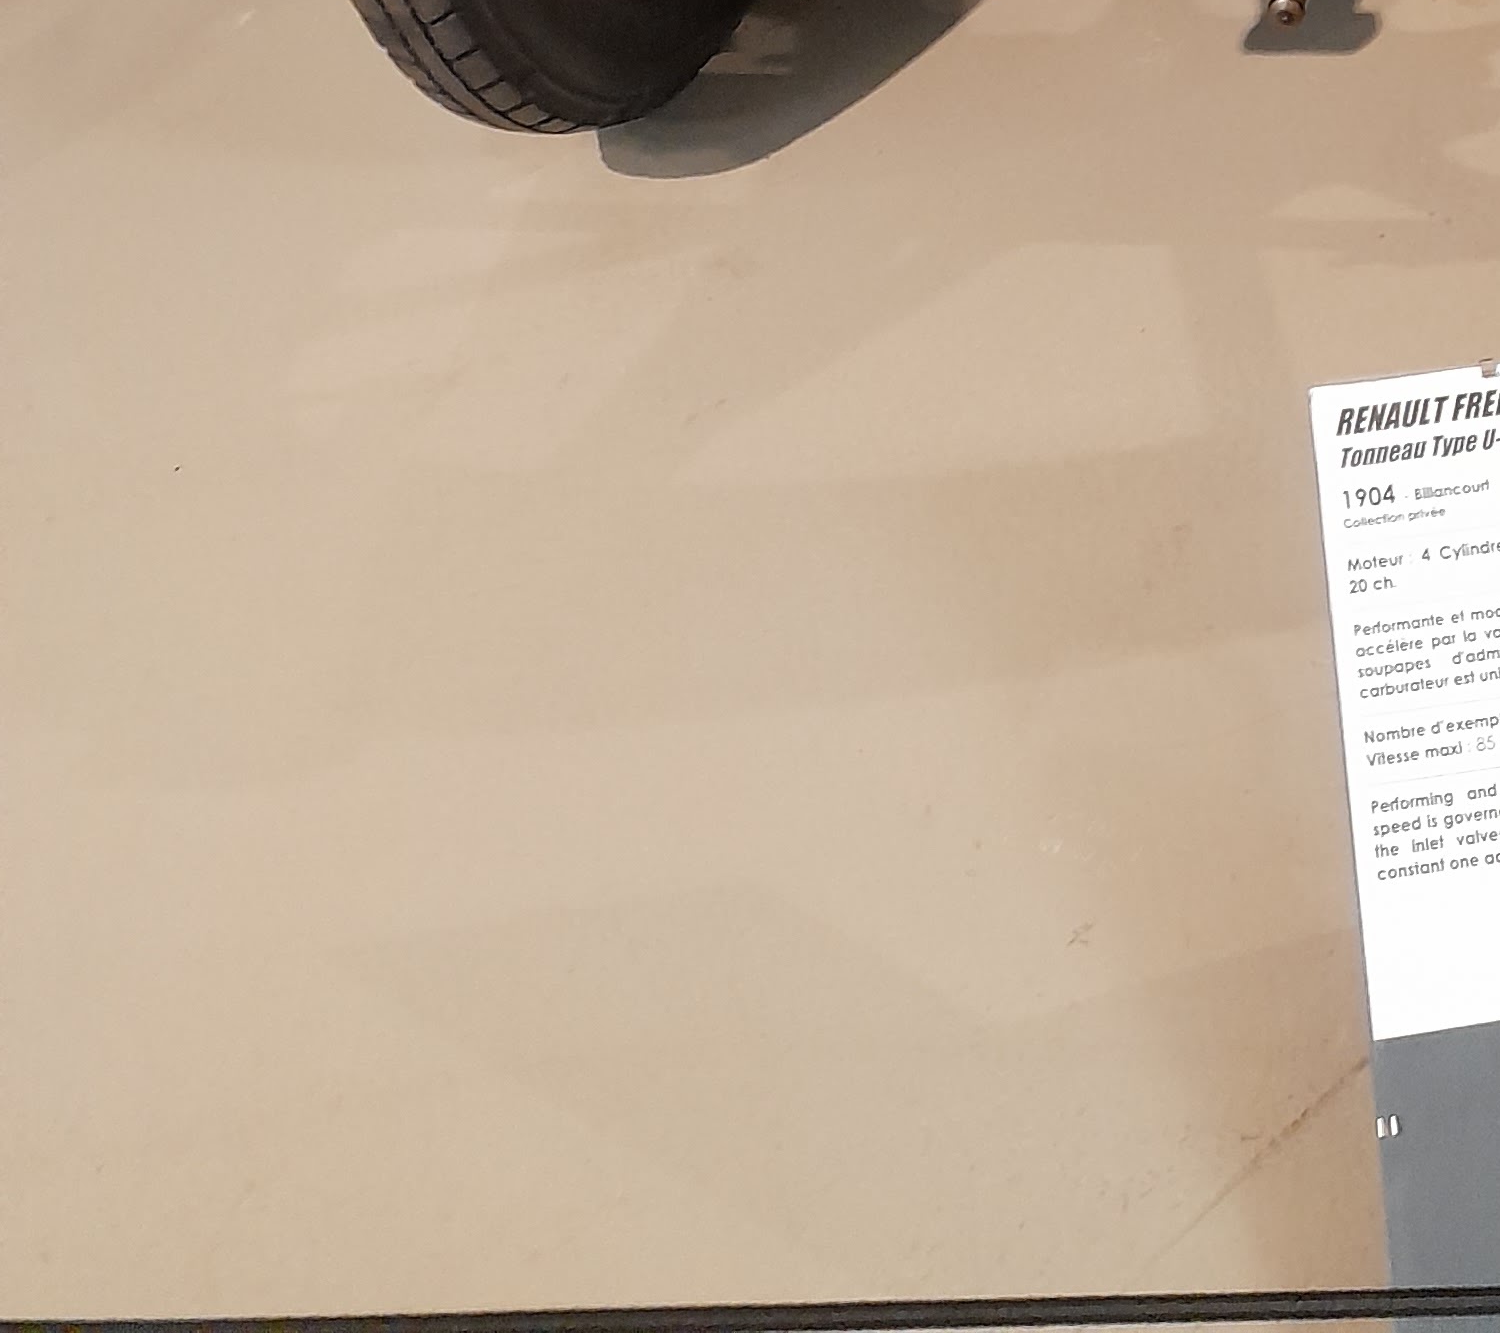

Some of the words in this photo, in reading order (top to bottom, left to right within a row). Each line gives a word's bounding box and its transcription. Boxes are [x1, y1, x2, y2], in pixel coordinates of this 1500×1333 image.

[1335, 395, 1449, 437] RENAULT
[1340, 440, 1428, 469] Tonneau
[1431, 433, 1479, 458] Type
[1342, 483, 1396, 510] 1904
[1343, 513, 1405, 529] Collection
[1347, 554, 1404, 572] Moteur
[1421, 547, 1431, 562] 4
[1348, 578, 1368, 595] 20
[1353, 613, 1445, 637] Performante
[1450, 609, 1465, 624] et
[1355, 637, 1424, 658] accélère
[1431, 634, 1456, 651] par
[1462, 629, 1478, 643] la
[1356, 658, 1432, 679] soupapes
[1359, 676, 1450, 700] carburateur
[1453, 670, 1475, 686] est
[1363, 725, 1427, 744] Nombre
[1365, 750, 1420, 767] Vitesse
[1424, 740, 1463, 759] maxi
[1370, 791, 1454, 815] Performing
[1466, 783, 1498, 801] and
[1372, 815, 1422, 838] speed
[1426, 814, 1439, 829] is
[1374, 843, 1400, 859] the
[1411, 834, 1445, 853] inlet
[1377, 857, 1446, 881] constant
[1449, 855, 1480, 871] one
